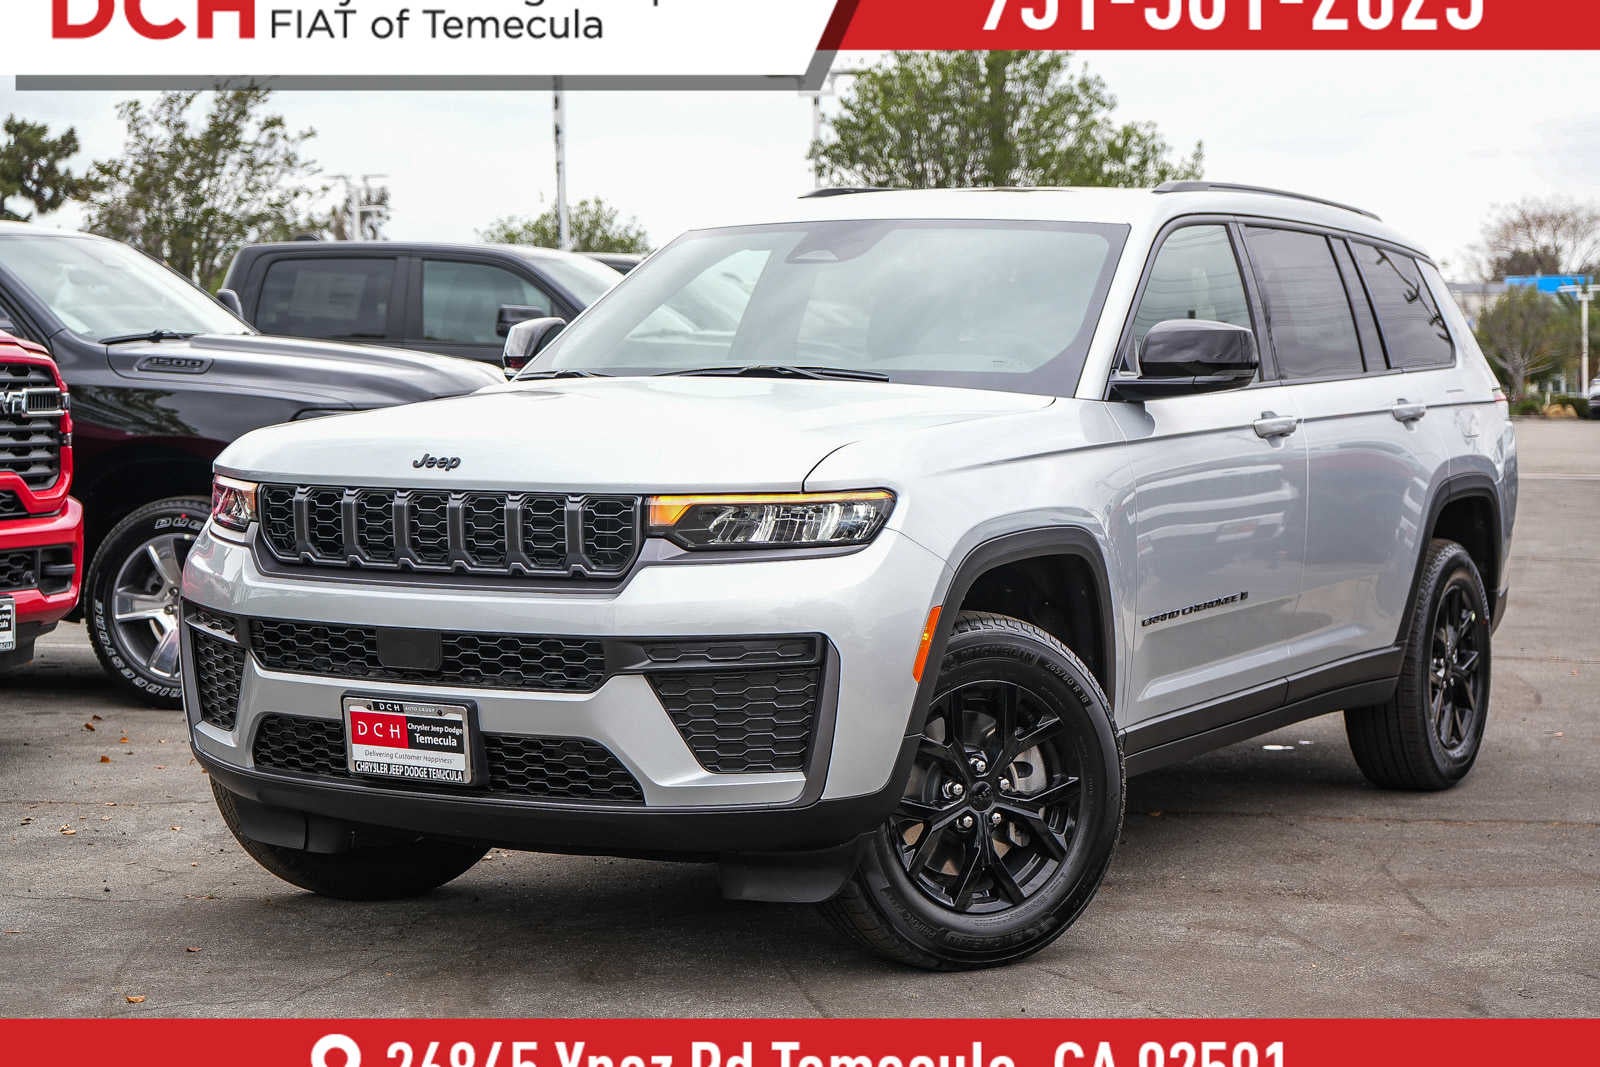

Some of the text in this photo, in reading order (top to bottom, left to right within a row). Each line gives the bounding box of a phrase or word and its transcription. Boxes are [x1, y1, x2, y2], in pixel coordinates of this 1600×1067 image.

[412, 453, 462, 472] Jeep
[1141, 608, 1181, 627] GRAND
[1181, 592, 1240, 616] CHEROKEE
[357, 720, 401, 740] DCH
[407, 722, 463, 736] Chrysler Jeep Dodge
[414, 733, 457, 747] Temecula
[355, 761, 463, 782] CHRYSLER JEEP DODGE TEMECULA
